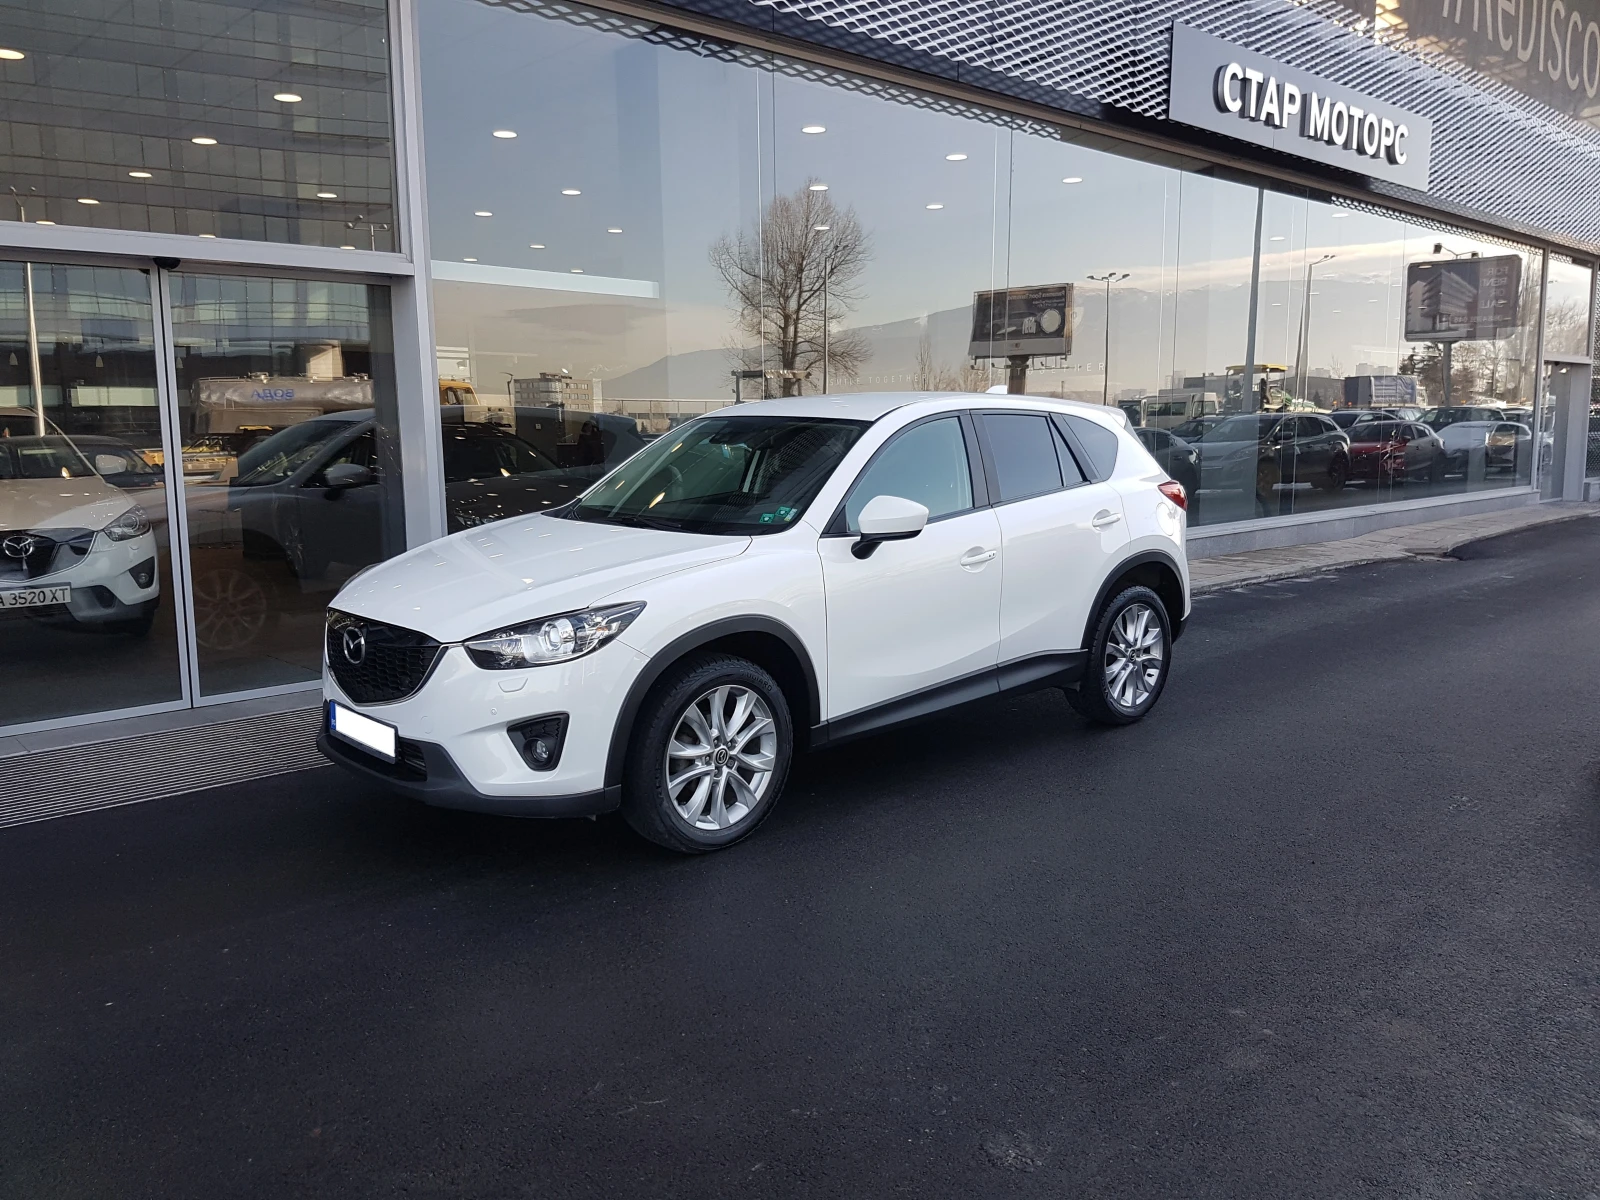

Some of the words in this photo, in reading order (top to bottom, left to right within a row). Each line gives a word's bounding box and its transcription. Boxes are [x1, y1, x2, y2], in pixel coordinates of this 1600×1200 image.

[1442, 0, 1600, 99] eDISCO
[1222, 62, 1301, 129] СТАР
[1308, 91, 1409, 165] МОТОРС
[868, 373, 928, 384] TOGETHER
[8, 590, 46, 606] 3520
[49, 588, 69, 603] XT
